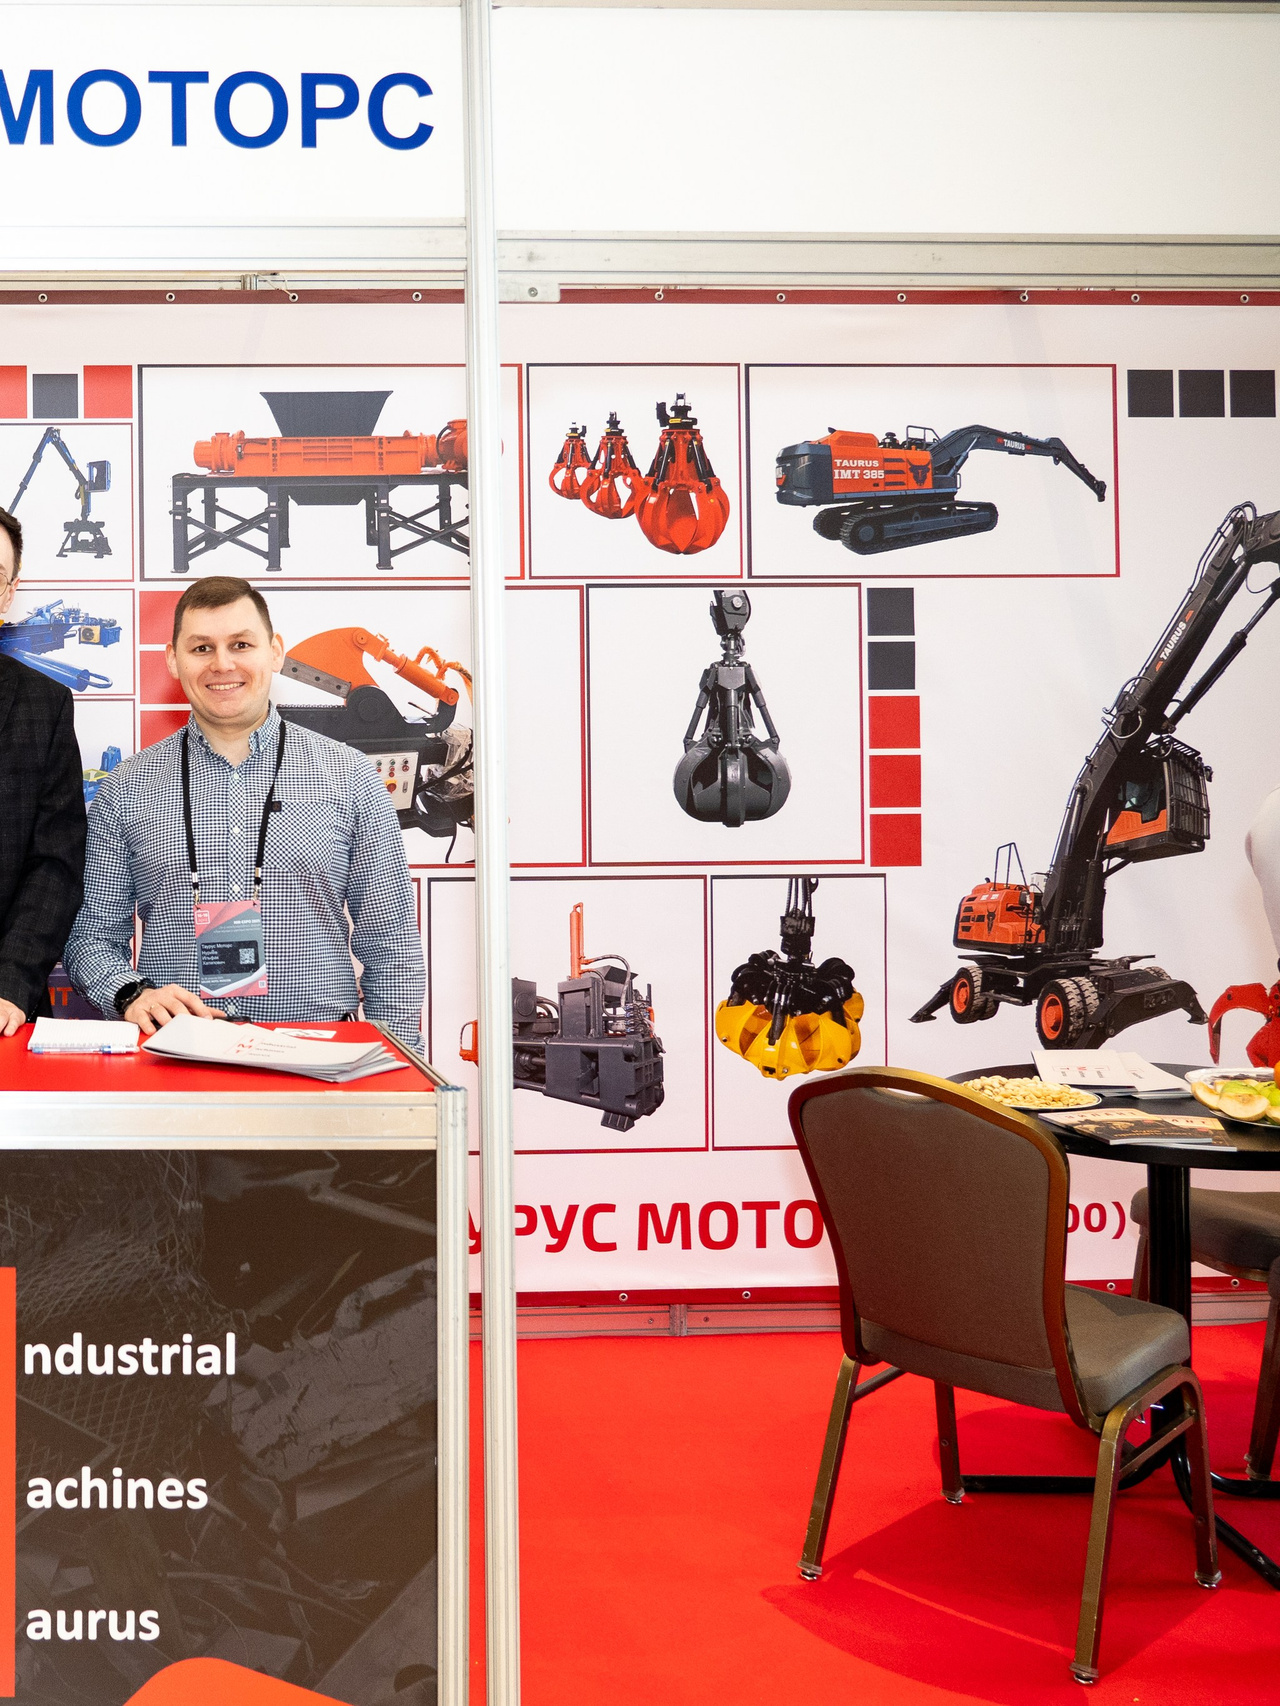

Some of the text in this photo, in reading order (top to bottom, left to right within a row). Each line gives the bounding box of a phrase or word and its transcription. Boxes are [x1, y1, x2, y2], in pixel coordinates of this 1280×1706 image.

[1003, 438, 1026, 451] TAURUS
[834, 459, 880, 468] TAURUS
[833, 468, 886, 480] IMT 385
[1159, 621, 1188, 661] TAURUS
